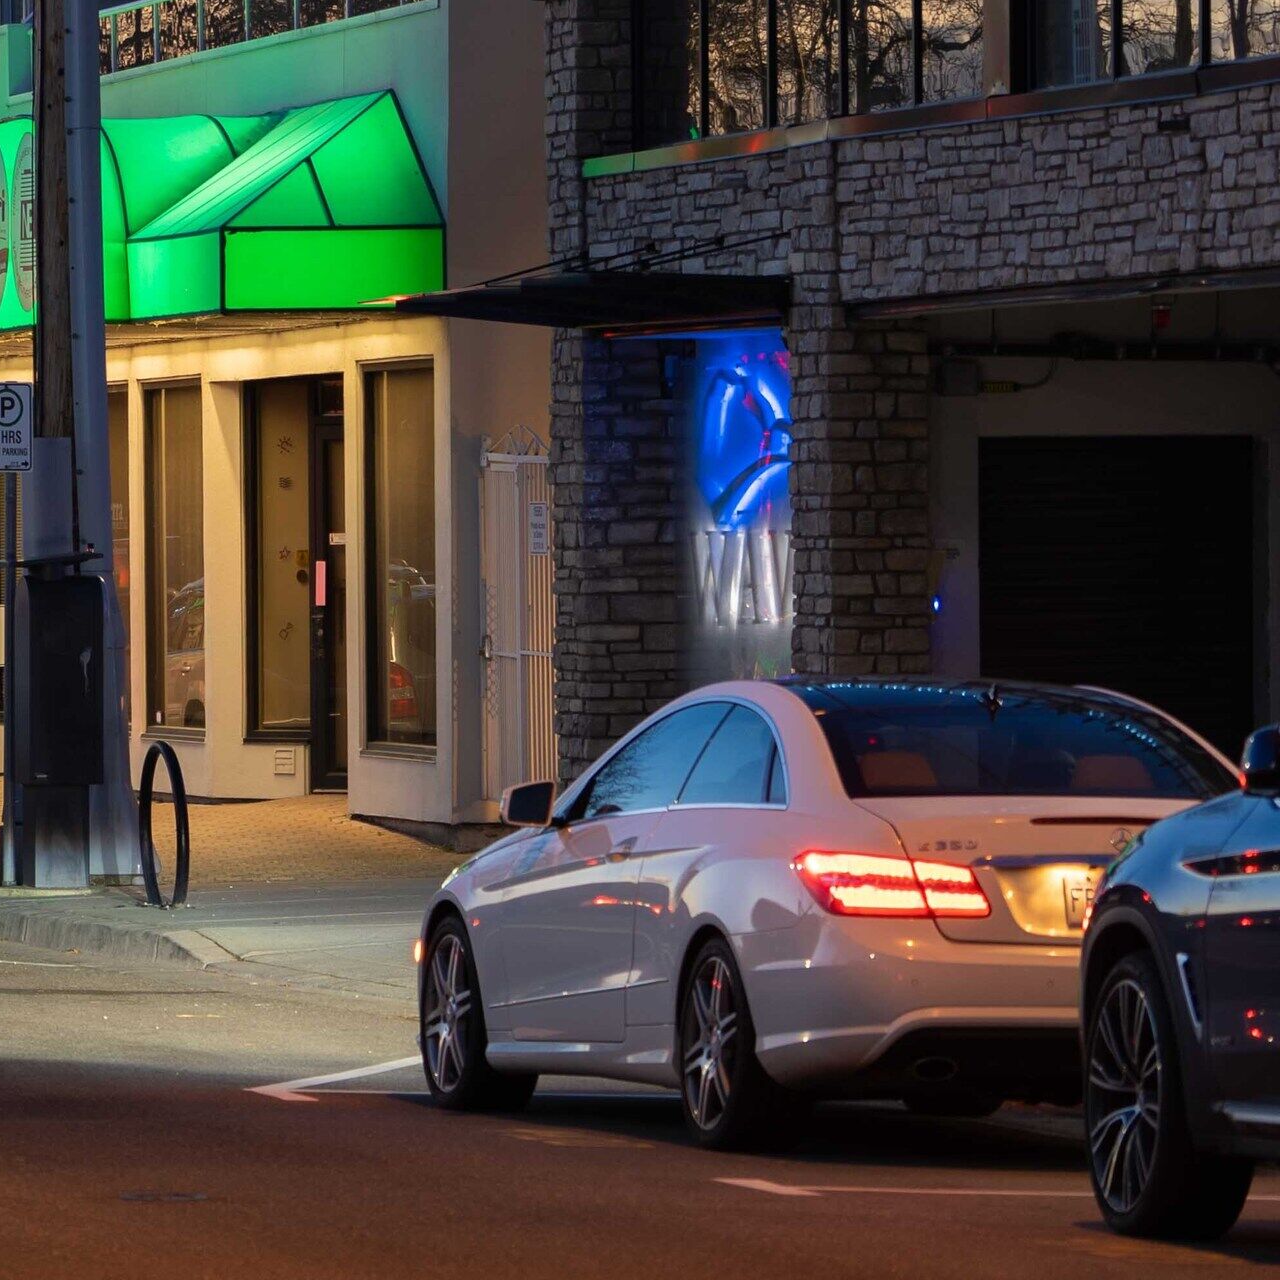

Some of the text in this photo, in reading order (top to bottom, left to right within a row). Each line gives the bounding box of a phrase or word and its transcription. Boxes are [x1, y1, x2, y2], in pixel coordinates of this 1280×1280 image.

[0, 396, 16, 419] P
[1, 430, 22, 444] HRS
[2, 447, 28, 457] PARKING
